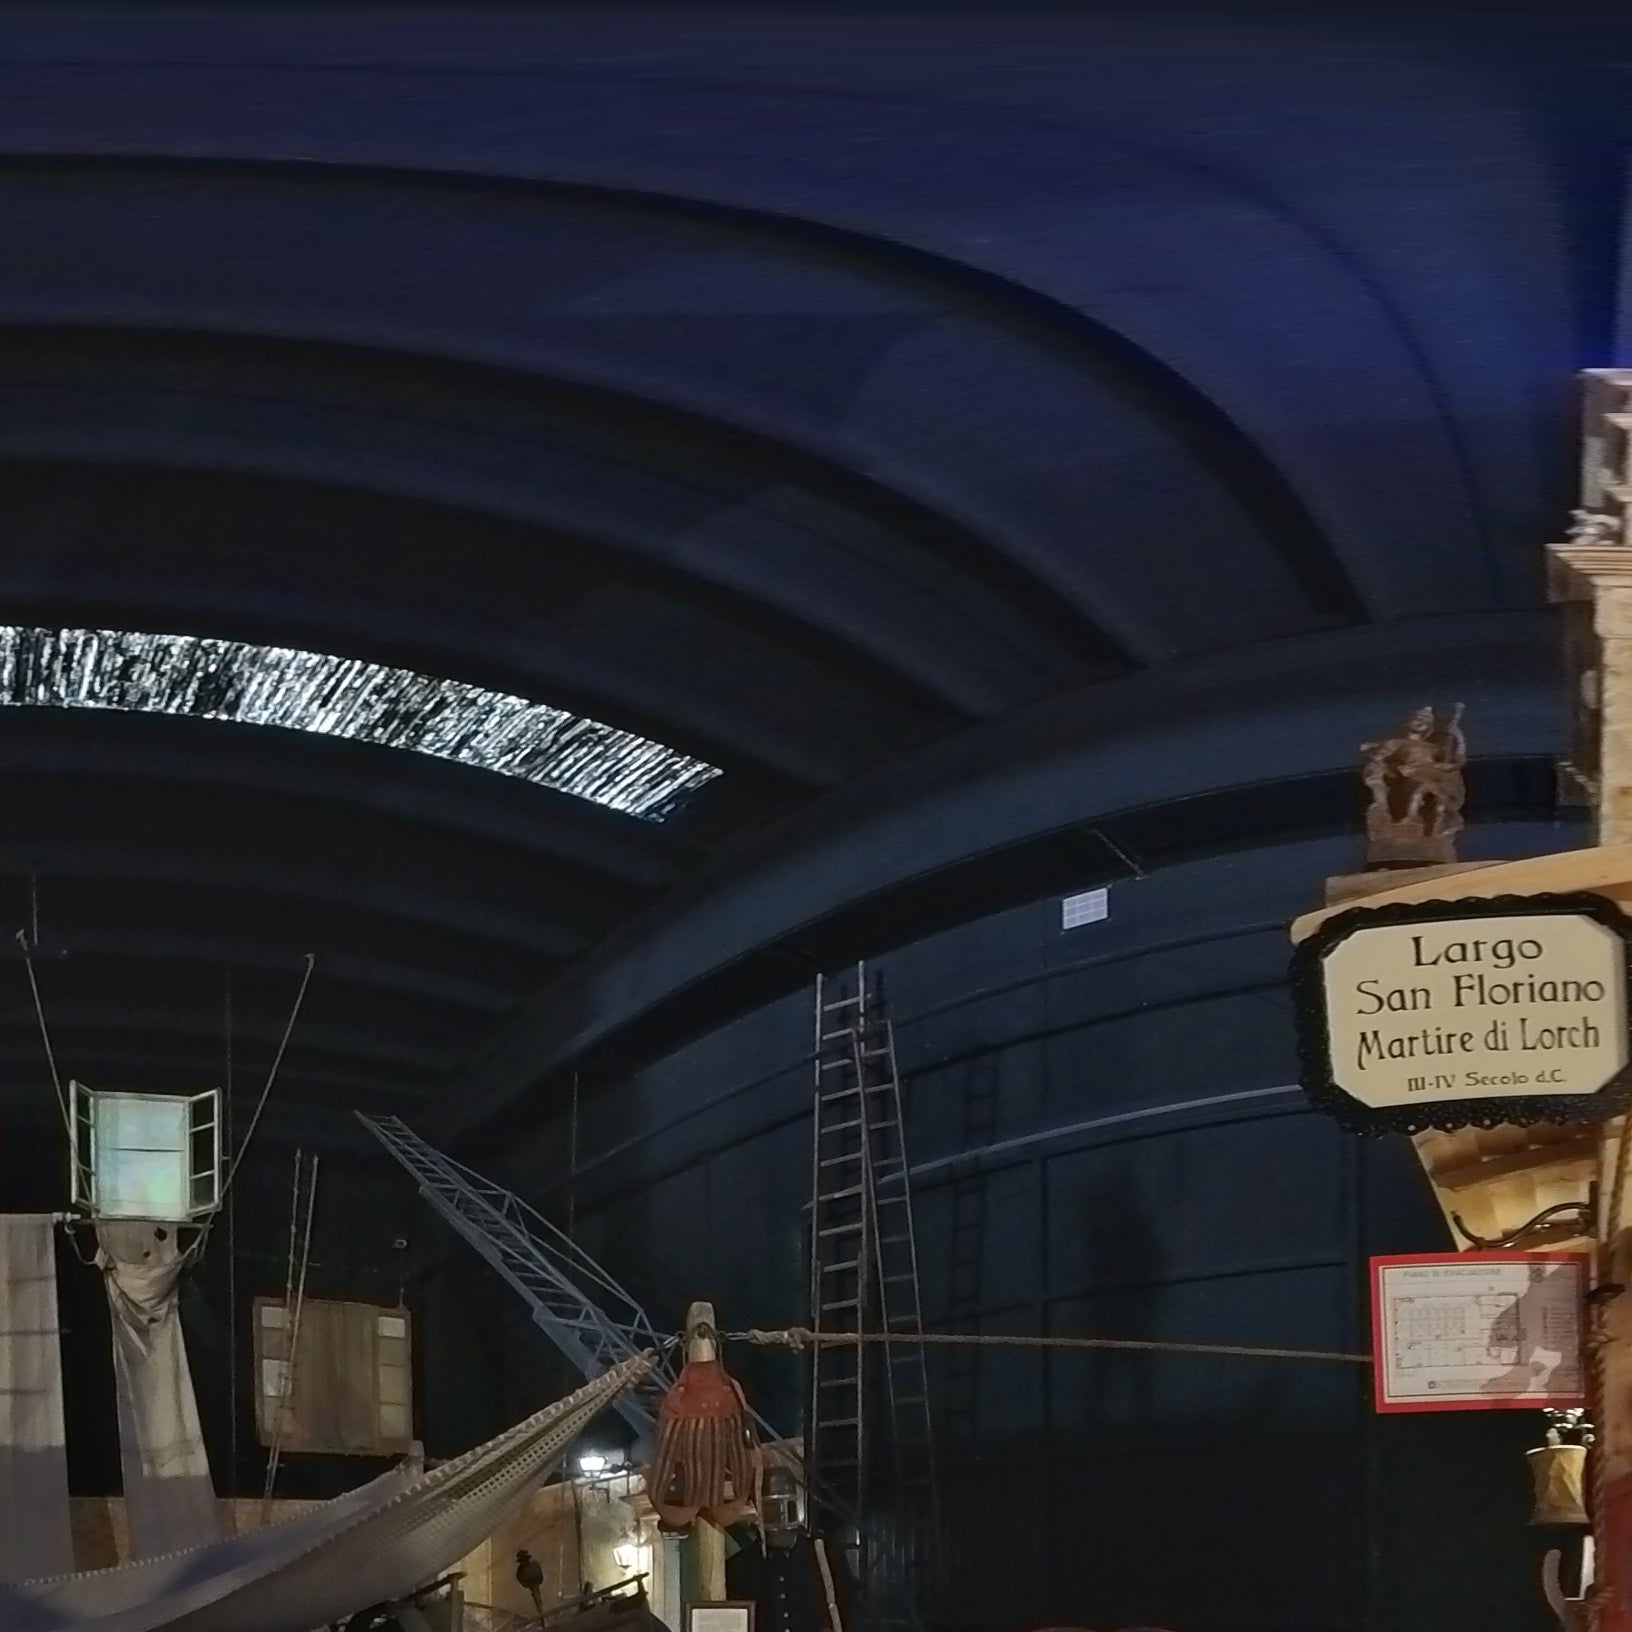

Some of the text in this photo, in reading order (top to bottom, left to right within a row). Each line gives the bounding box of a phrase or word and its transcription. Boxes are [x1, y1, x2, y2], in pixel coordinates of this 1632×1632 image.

[1412, 934, 1543, 969] Largo
[1356, 974, 1606, 1015] San Floriano
[1357, 1016, 1600, 1070] Martire di Lorch
[1407, 1073, 1456, 1092] III-IV
[1466, 1070, 1529, 1087] Secolo
